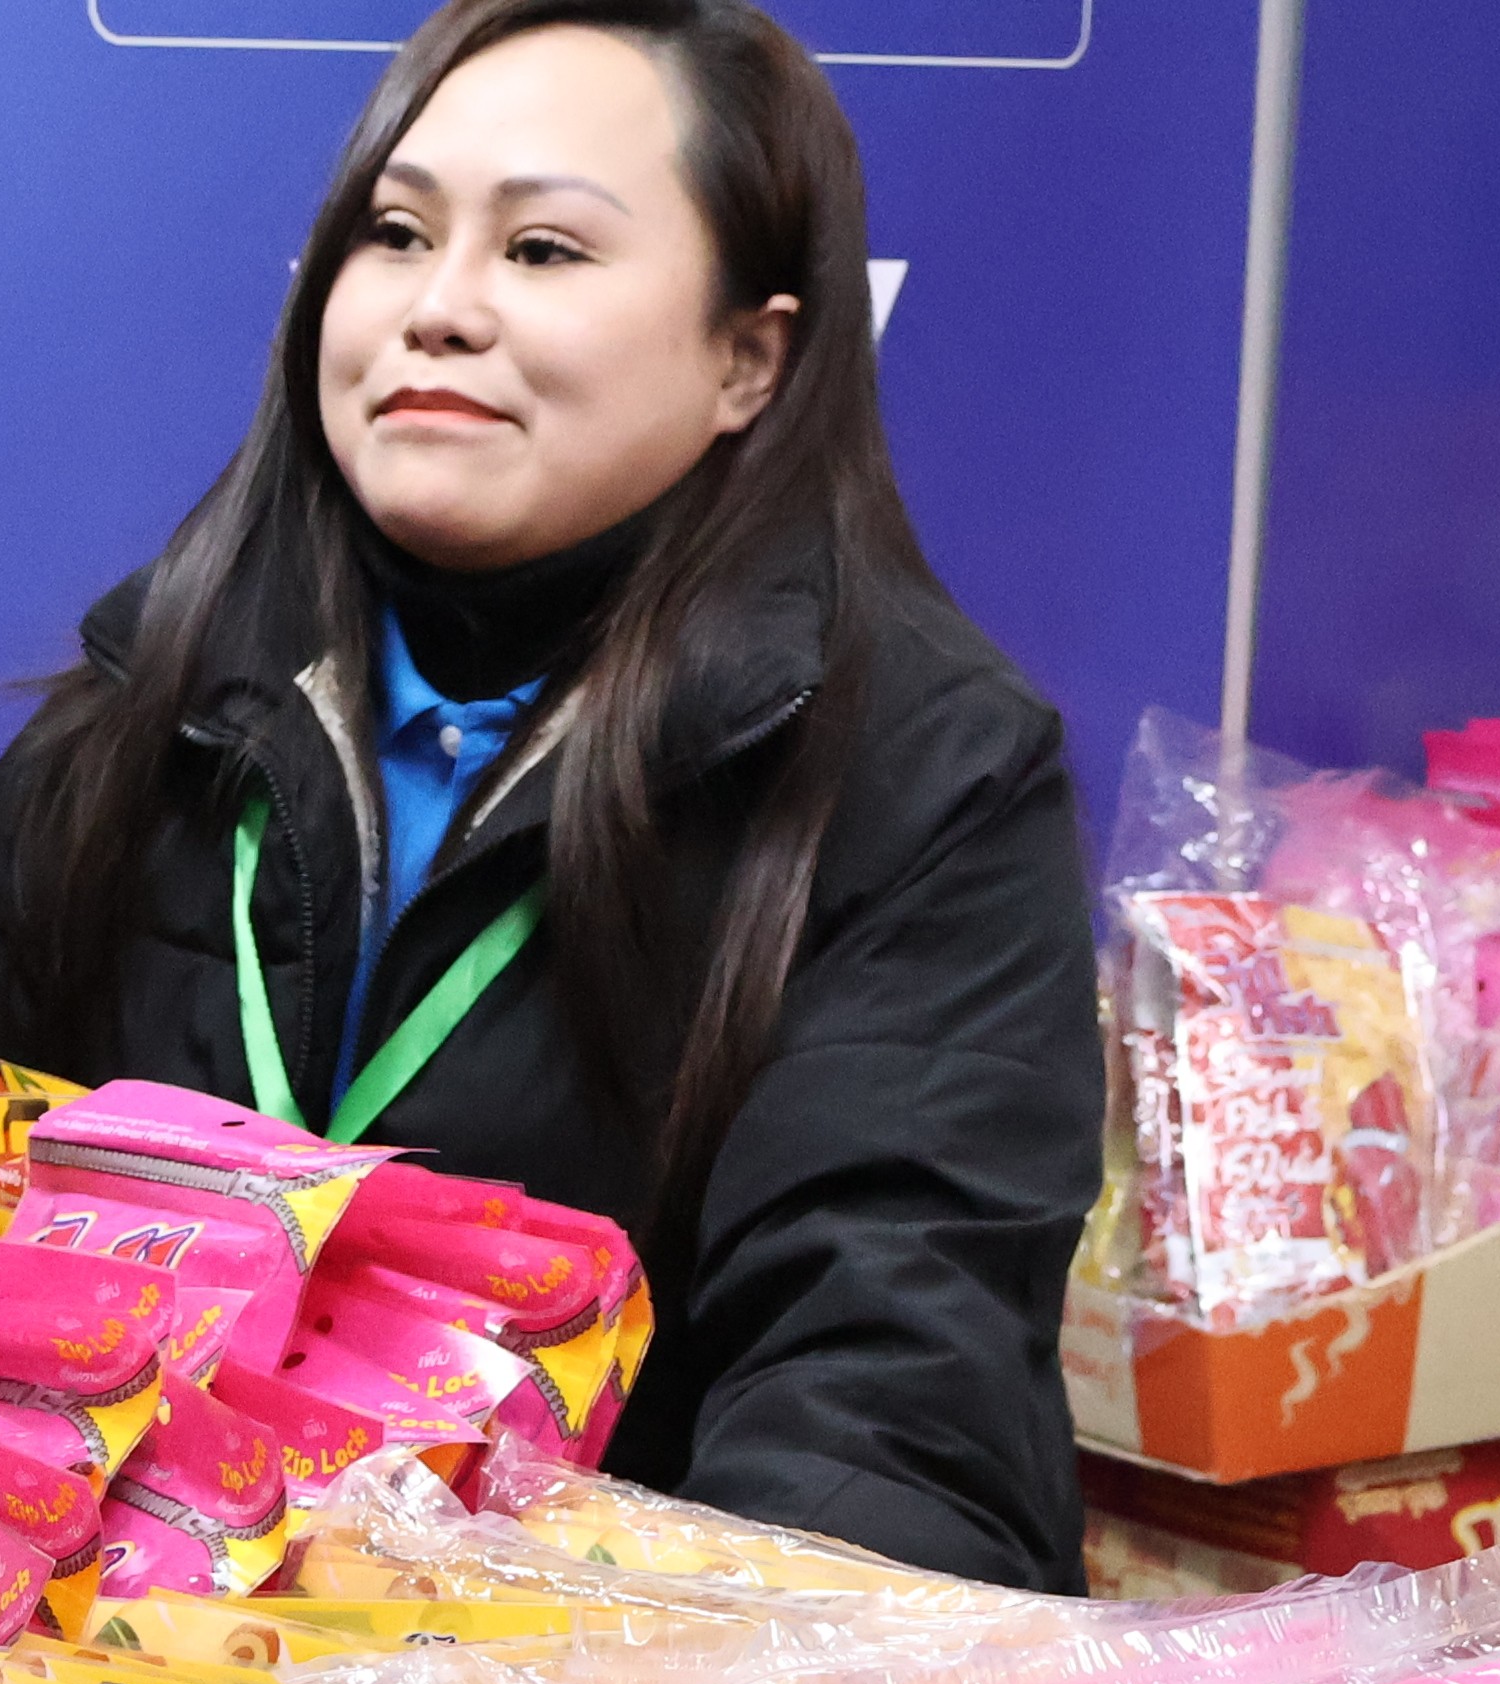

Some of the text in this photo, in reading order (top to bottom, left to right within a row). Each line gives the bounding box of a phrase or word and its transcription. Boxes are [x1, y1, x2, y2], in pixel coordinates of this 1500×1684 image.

[169, 1304, 223, 1361] Lock
[417, 1345, 452, 1369] เพิ่ม
[426, 1370, 484, 1399] Loc
[281, 1427, 370, 1481] Zip Lock
